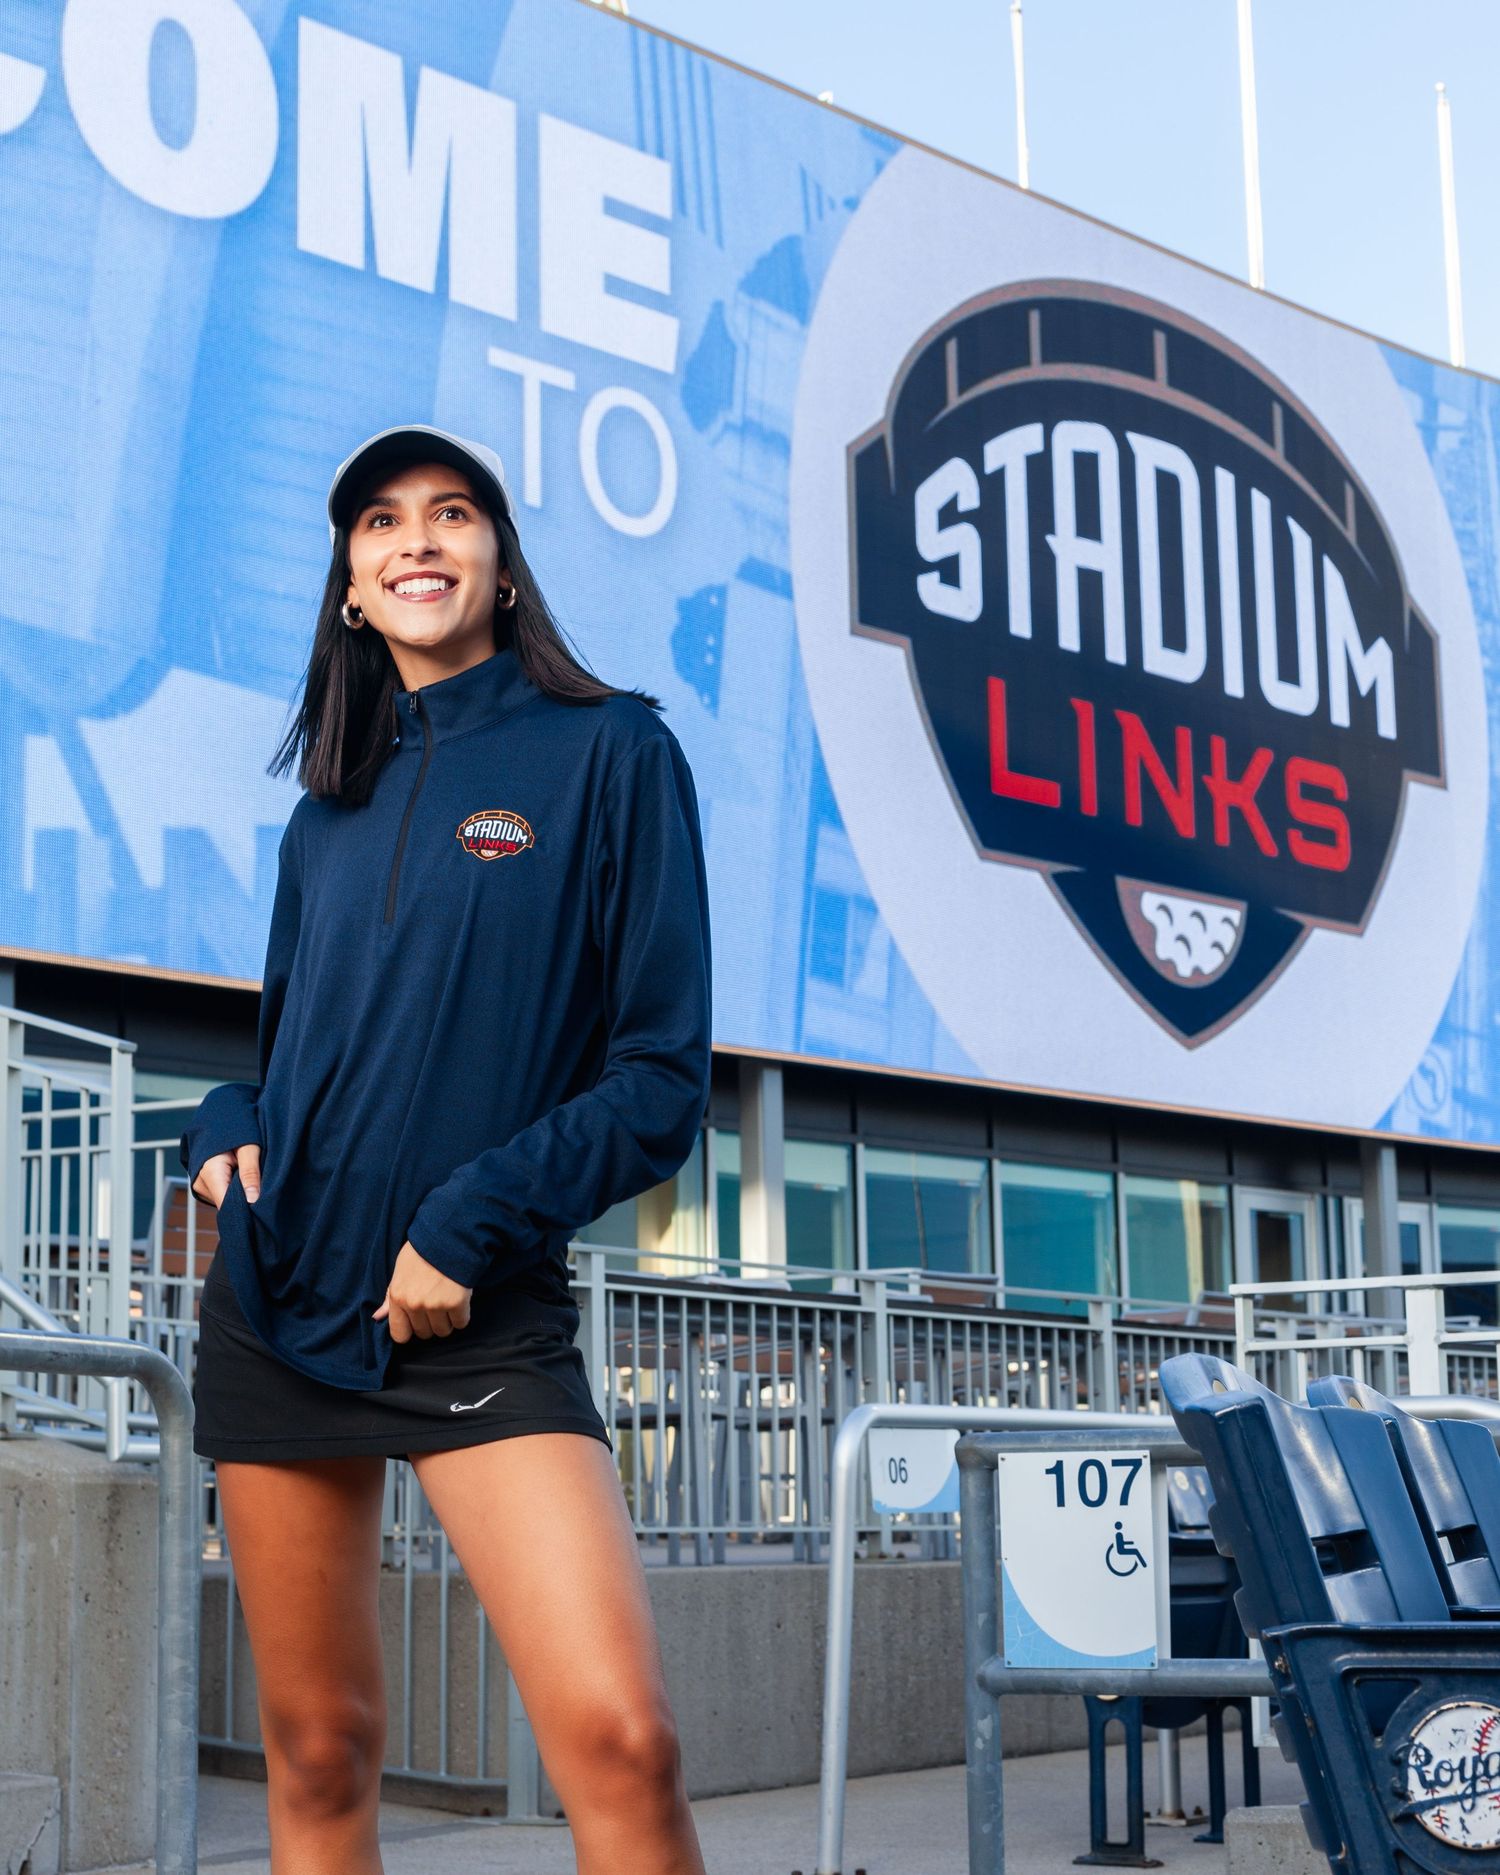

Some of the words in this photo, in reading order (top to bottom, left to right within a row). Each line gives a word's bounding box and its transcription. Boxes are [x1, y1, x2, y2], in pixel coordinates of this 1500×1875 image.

[0, 0, 679, 373] OME
[487, 348, 678, 537] TO
[914, 420, 1397, 741] STADIUM
[464, 820, 528, 843] STADIUM
[468, 838, 517, 851] LINKS
[987, 676, 1351, 872] LINKS
[1045, 1458, 1143, 1508] 107
